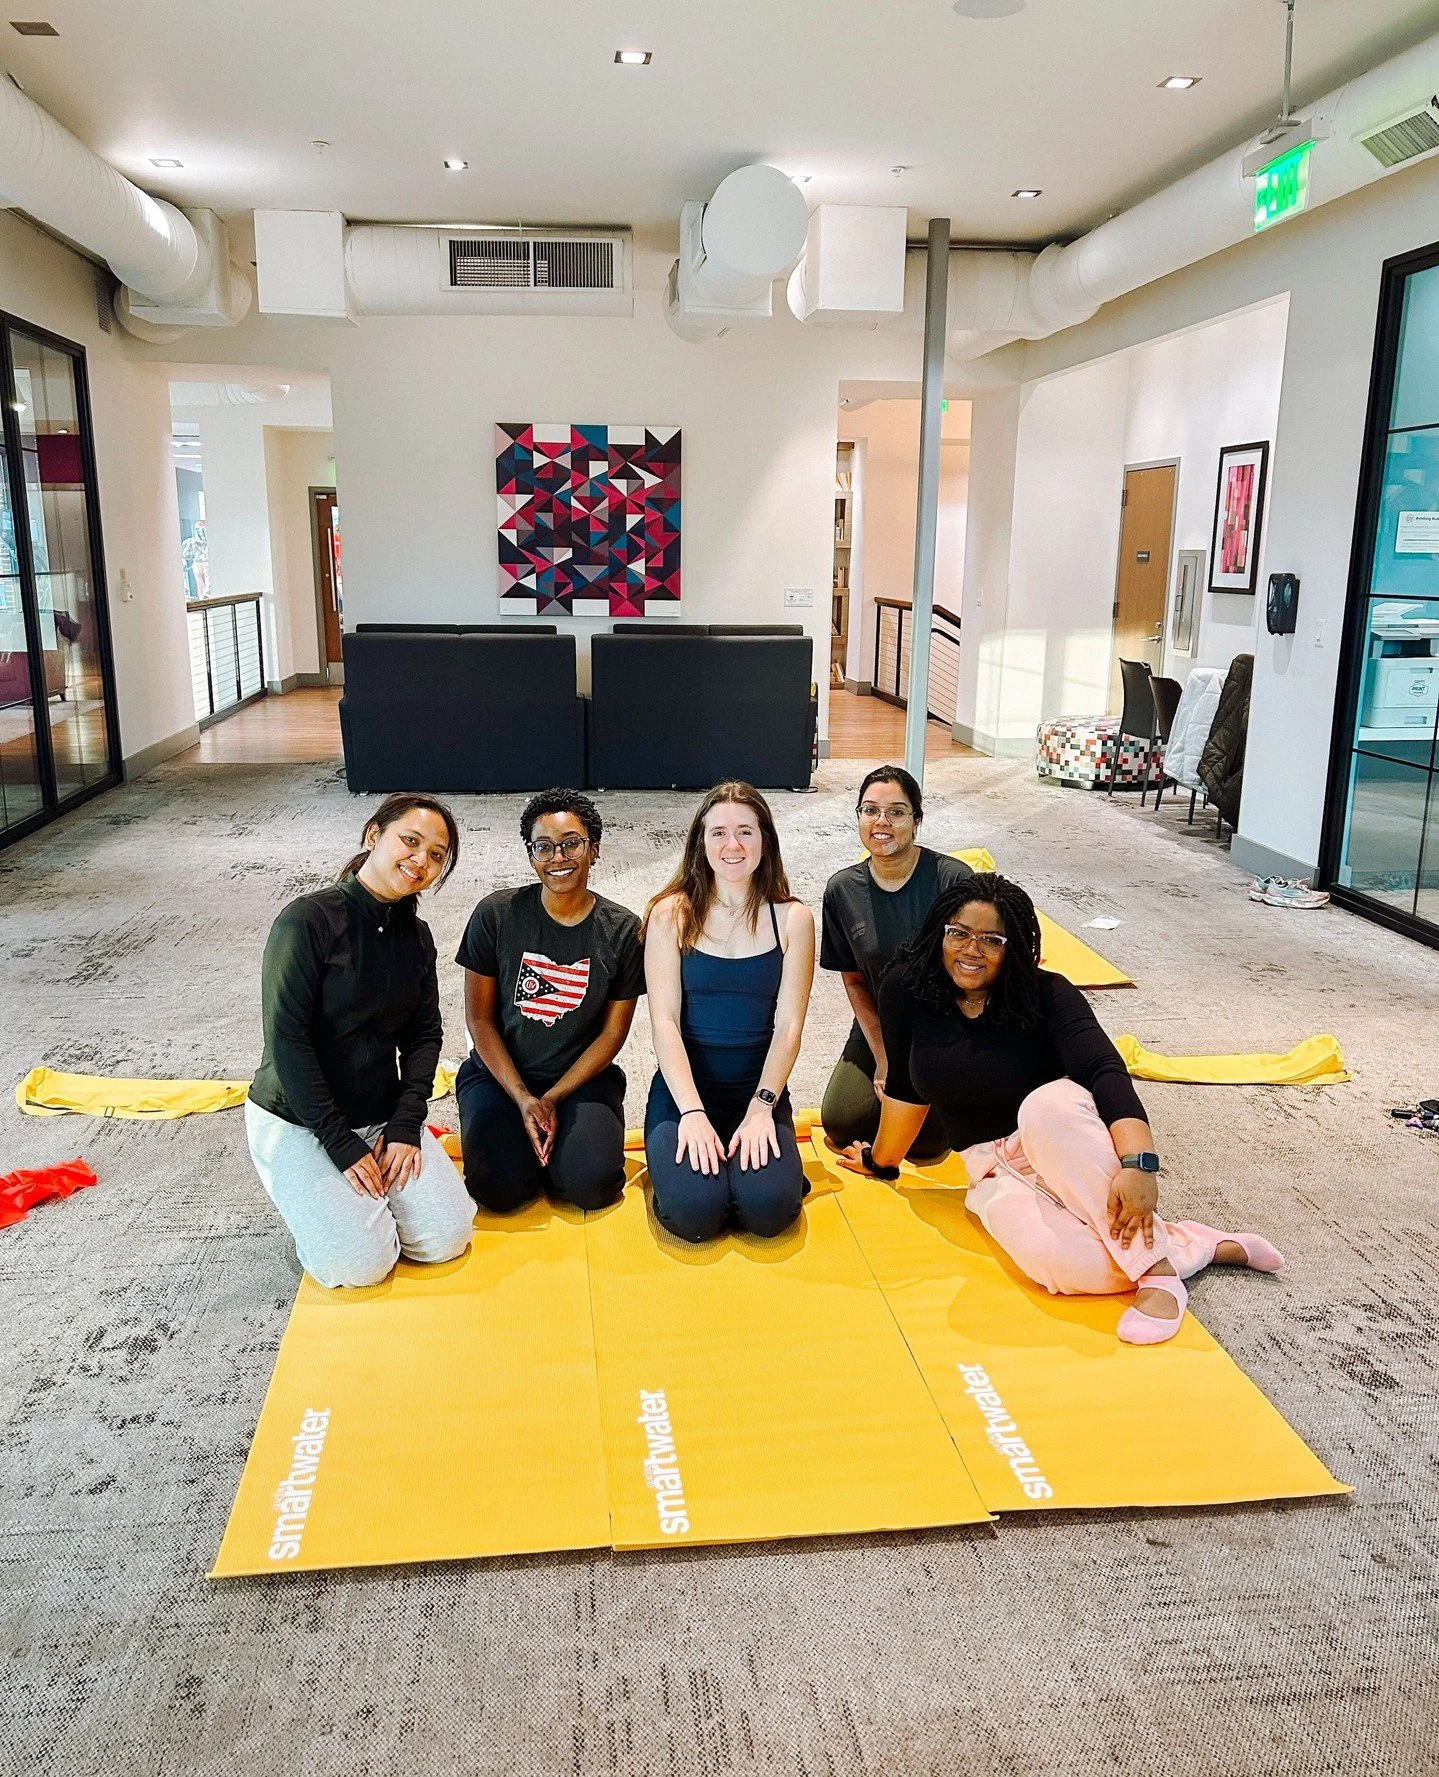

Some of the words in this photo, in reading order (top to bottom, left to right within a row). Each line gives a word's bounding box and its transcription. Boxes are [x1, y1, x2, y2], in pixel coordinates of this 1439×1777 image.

[268, 1407, 331, 1559] smartwater
[637, 1388, 690, 1535] smartwater
[957, 1363, 1053, 1499] smartwater
